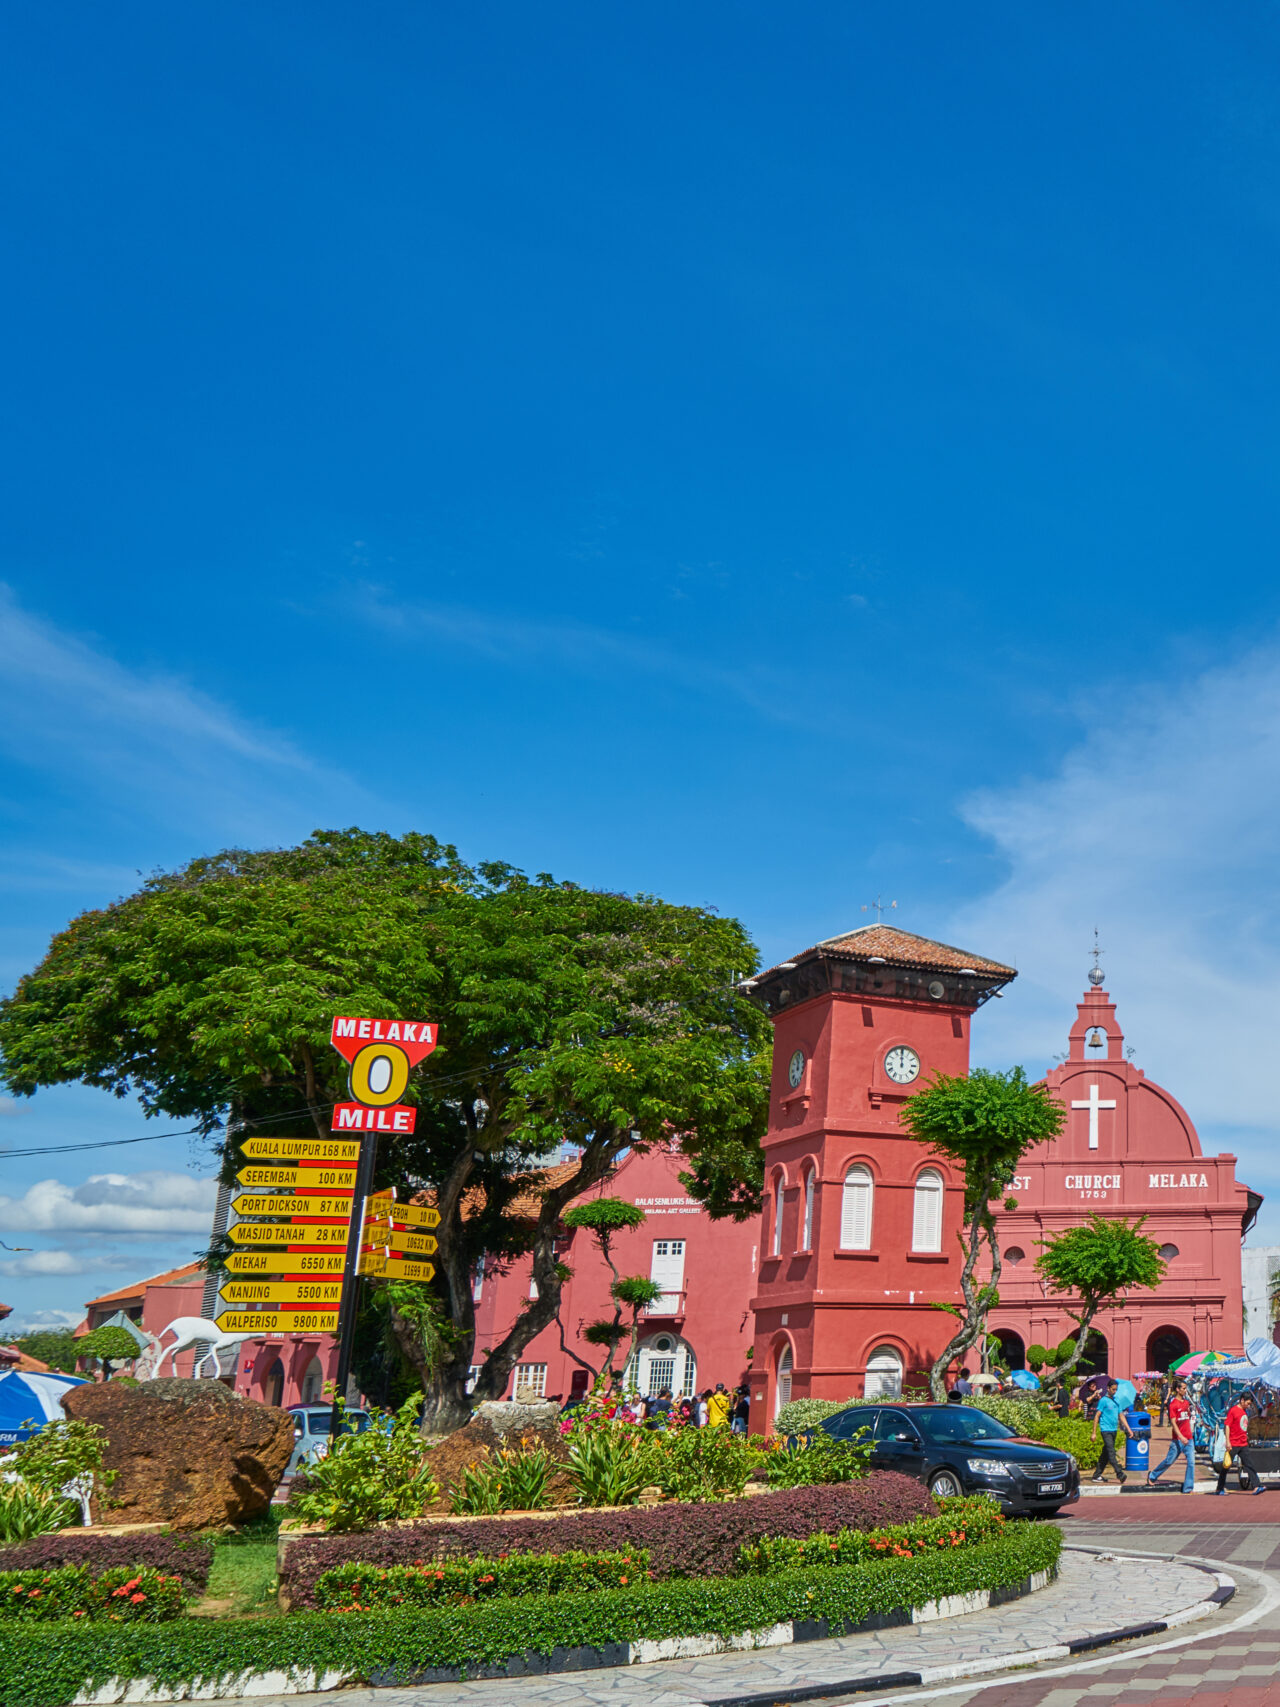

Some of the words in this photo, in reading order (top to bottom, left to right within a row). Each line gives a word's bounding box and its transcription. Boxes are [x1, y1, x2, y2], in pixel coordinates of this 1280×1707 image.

[336, 1018, 433, 1043] MELAKA
[338, 1108, 410, 1131] MILE
[249, 1142, 279, 1155] KUALA
[281, 1143, 321, 1156] LUMPUR
[322, 1145, 339, 1156] 168
[341, 1145, 356, 1157] KM
[245, 1170, 297, 1183] SEREMBAN
[318, 1172, 335, 1184] 100
[338, 1173, 352, 1185] KM
[1065, 1174, 1121, 1189] CHURCH
[1148, 1173, 1208, 1188] MELAKA
[241, 1198, 266, 1211] PORT
[268, 1200, 309, 1212] DICKSON
[320, 1200, 332, 1213] 87
[334, 1201, 349, 1213] KM
[237, 1227, 272, 1240] MASJID
[275, 1228, 305, 1240] TANAH
[316, 1229, 328, 1240] 28
[331, 1230, 345, 1241] KM
[233, 1256, 267, 1269] MEKAH
[301, 1257, 325, 1269] 6550
[327, 1258, 342, 1270] KM
[229, 1286, 271, 1298] NANJING
[297, 1286, 322, 1298] 5500
[323, 1287, 339, 1299] KM
[226, 1315, 278, 1328] VALPERISO
[293, 1316, 318, 1328] 9800
[320, 1316, 335, 1328] KM
